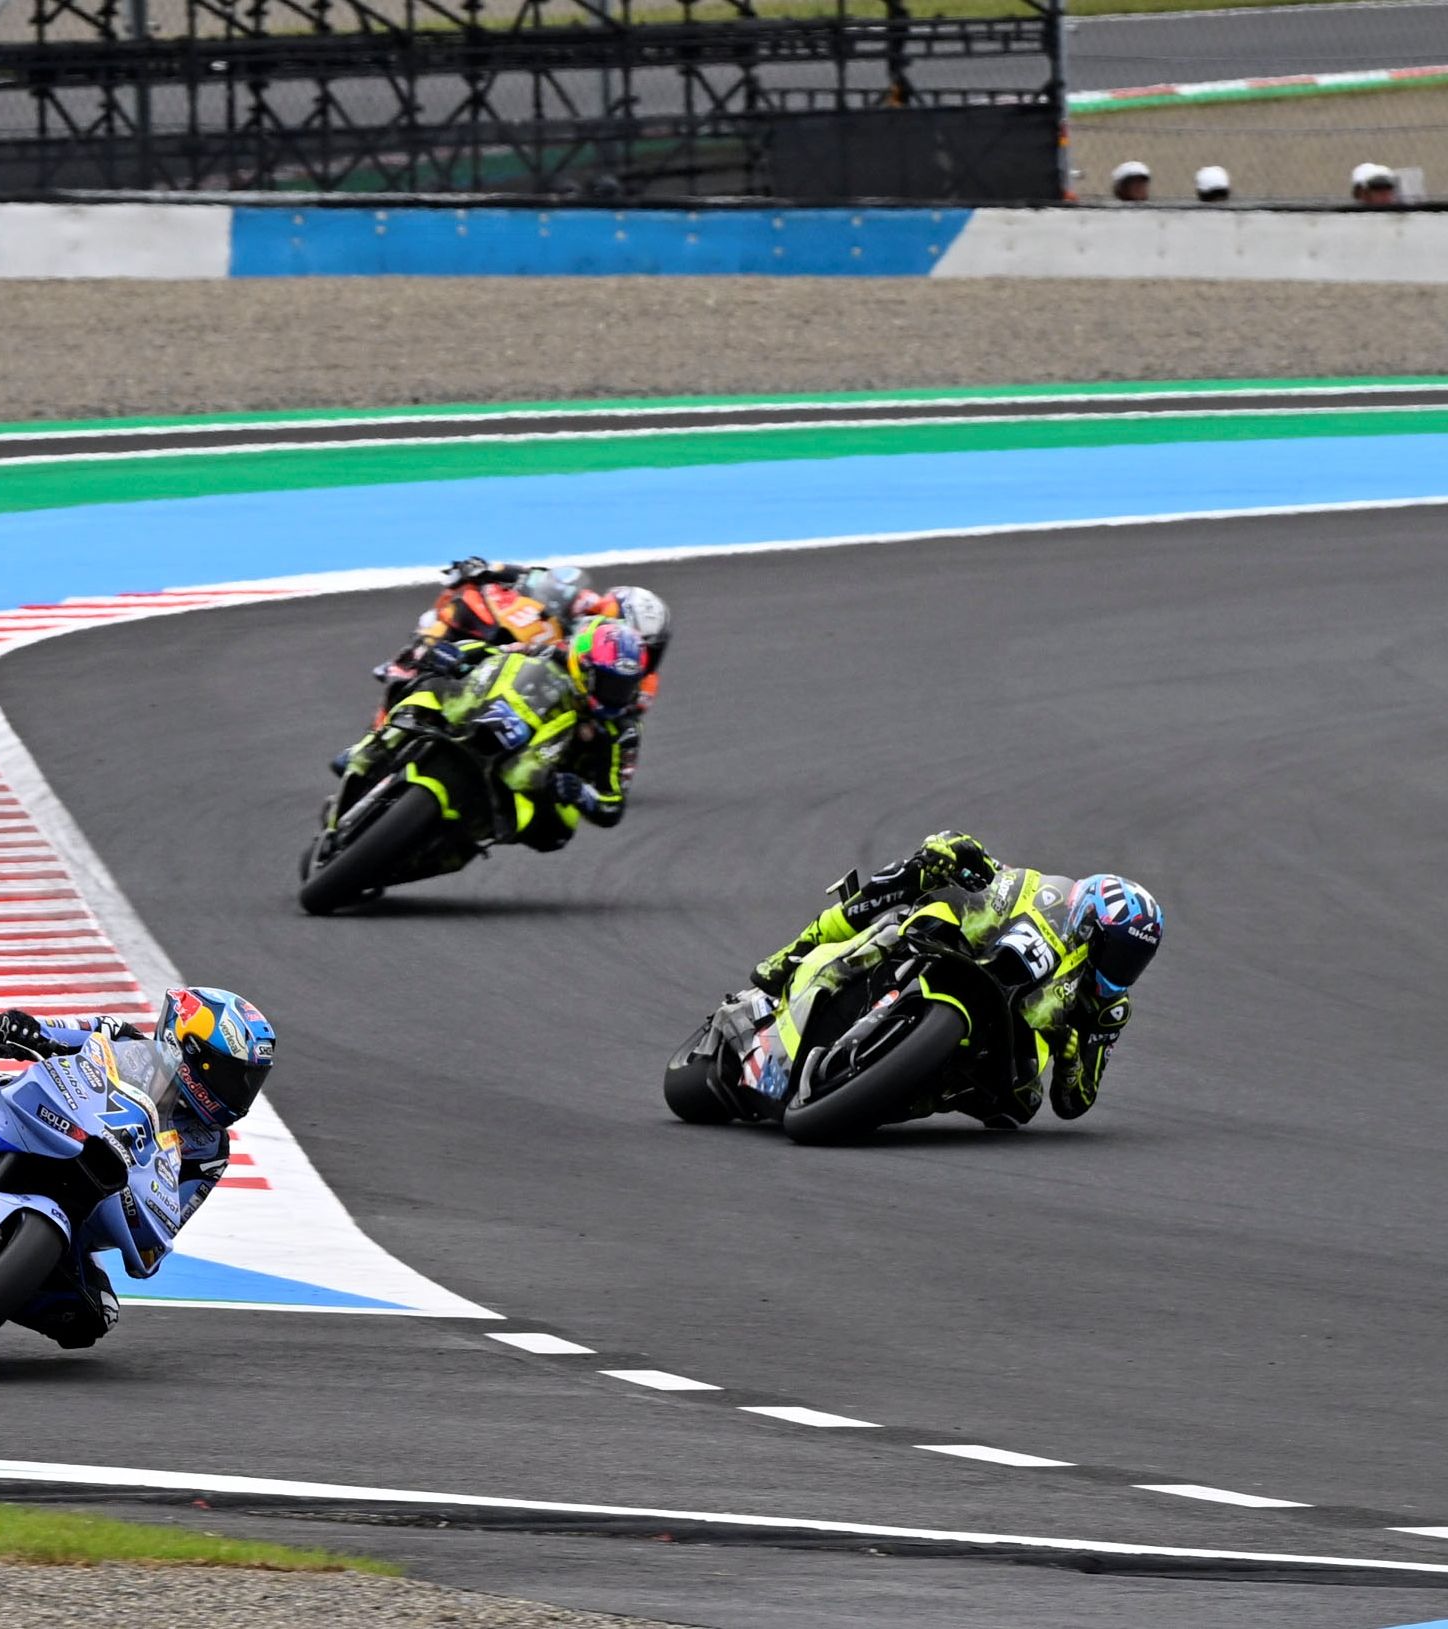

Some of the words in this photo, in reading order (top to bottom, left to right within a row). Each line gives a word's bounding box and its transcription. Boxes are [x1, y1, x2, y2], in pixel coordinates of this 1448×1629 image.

[1128, 926, 1158, 945] SHARK
[995, 920, 1054, 980] 25
[40, 1107, 71, 1131] BOLD
